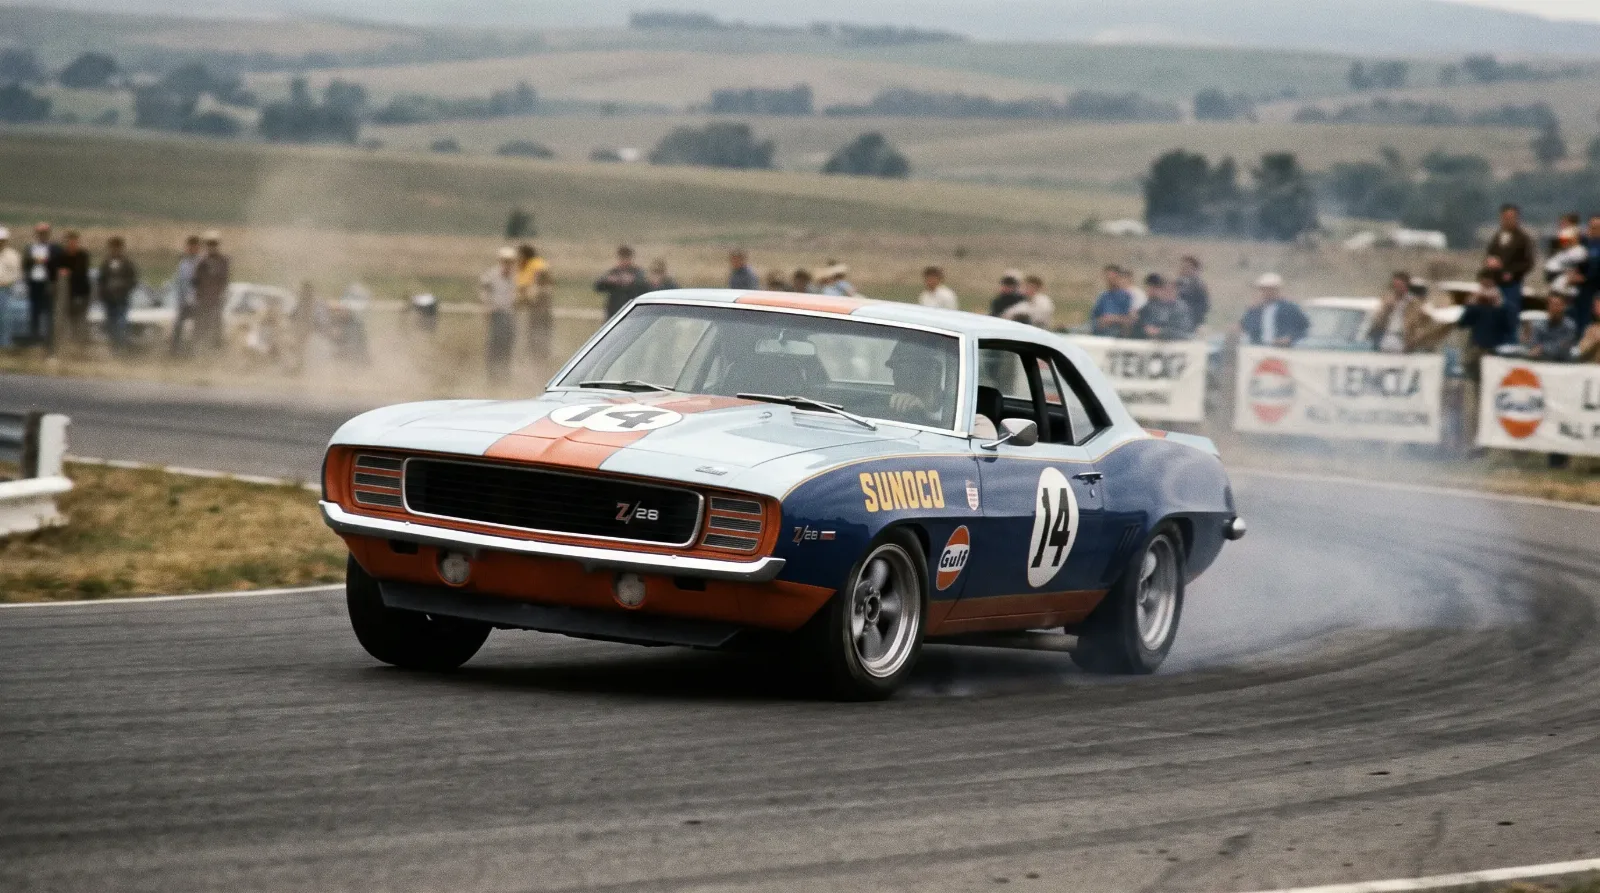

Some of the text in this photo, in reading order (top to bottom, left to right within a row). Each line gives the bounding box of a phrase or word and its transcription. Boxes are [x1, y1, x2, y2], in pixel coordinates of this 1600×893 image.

[564, 405, 669, 429] 14
[859, 469, 945, 512] SUNOCO
[615, 500, 659, 524] Z/28
[792, 524, 818, 546] Z/28
[1030, 487, 1071, 569] 14
[940, 549, 968, 568] Gulf
